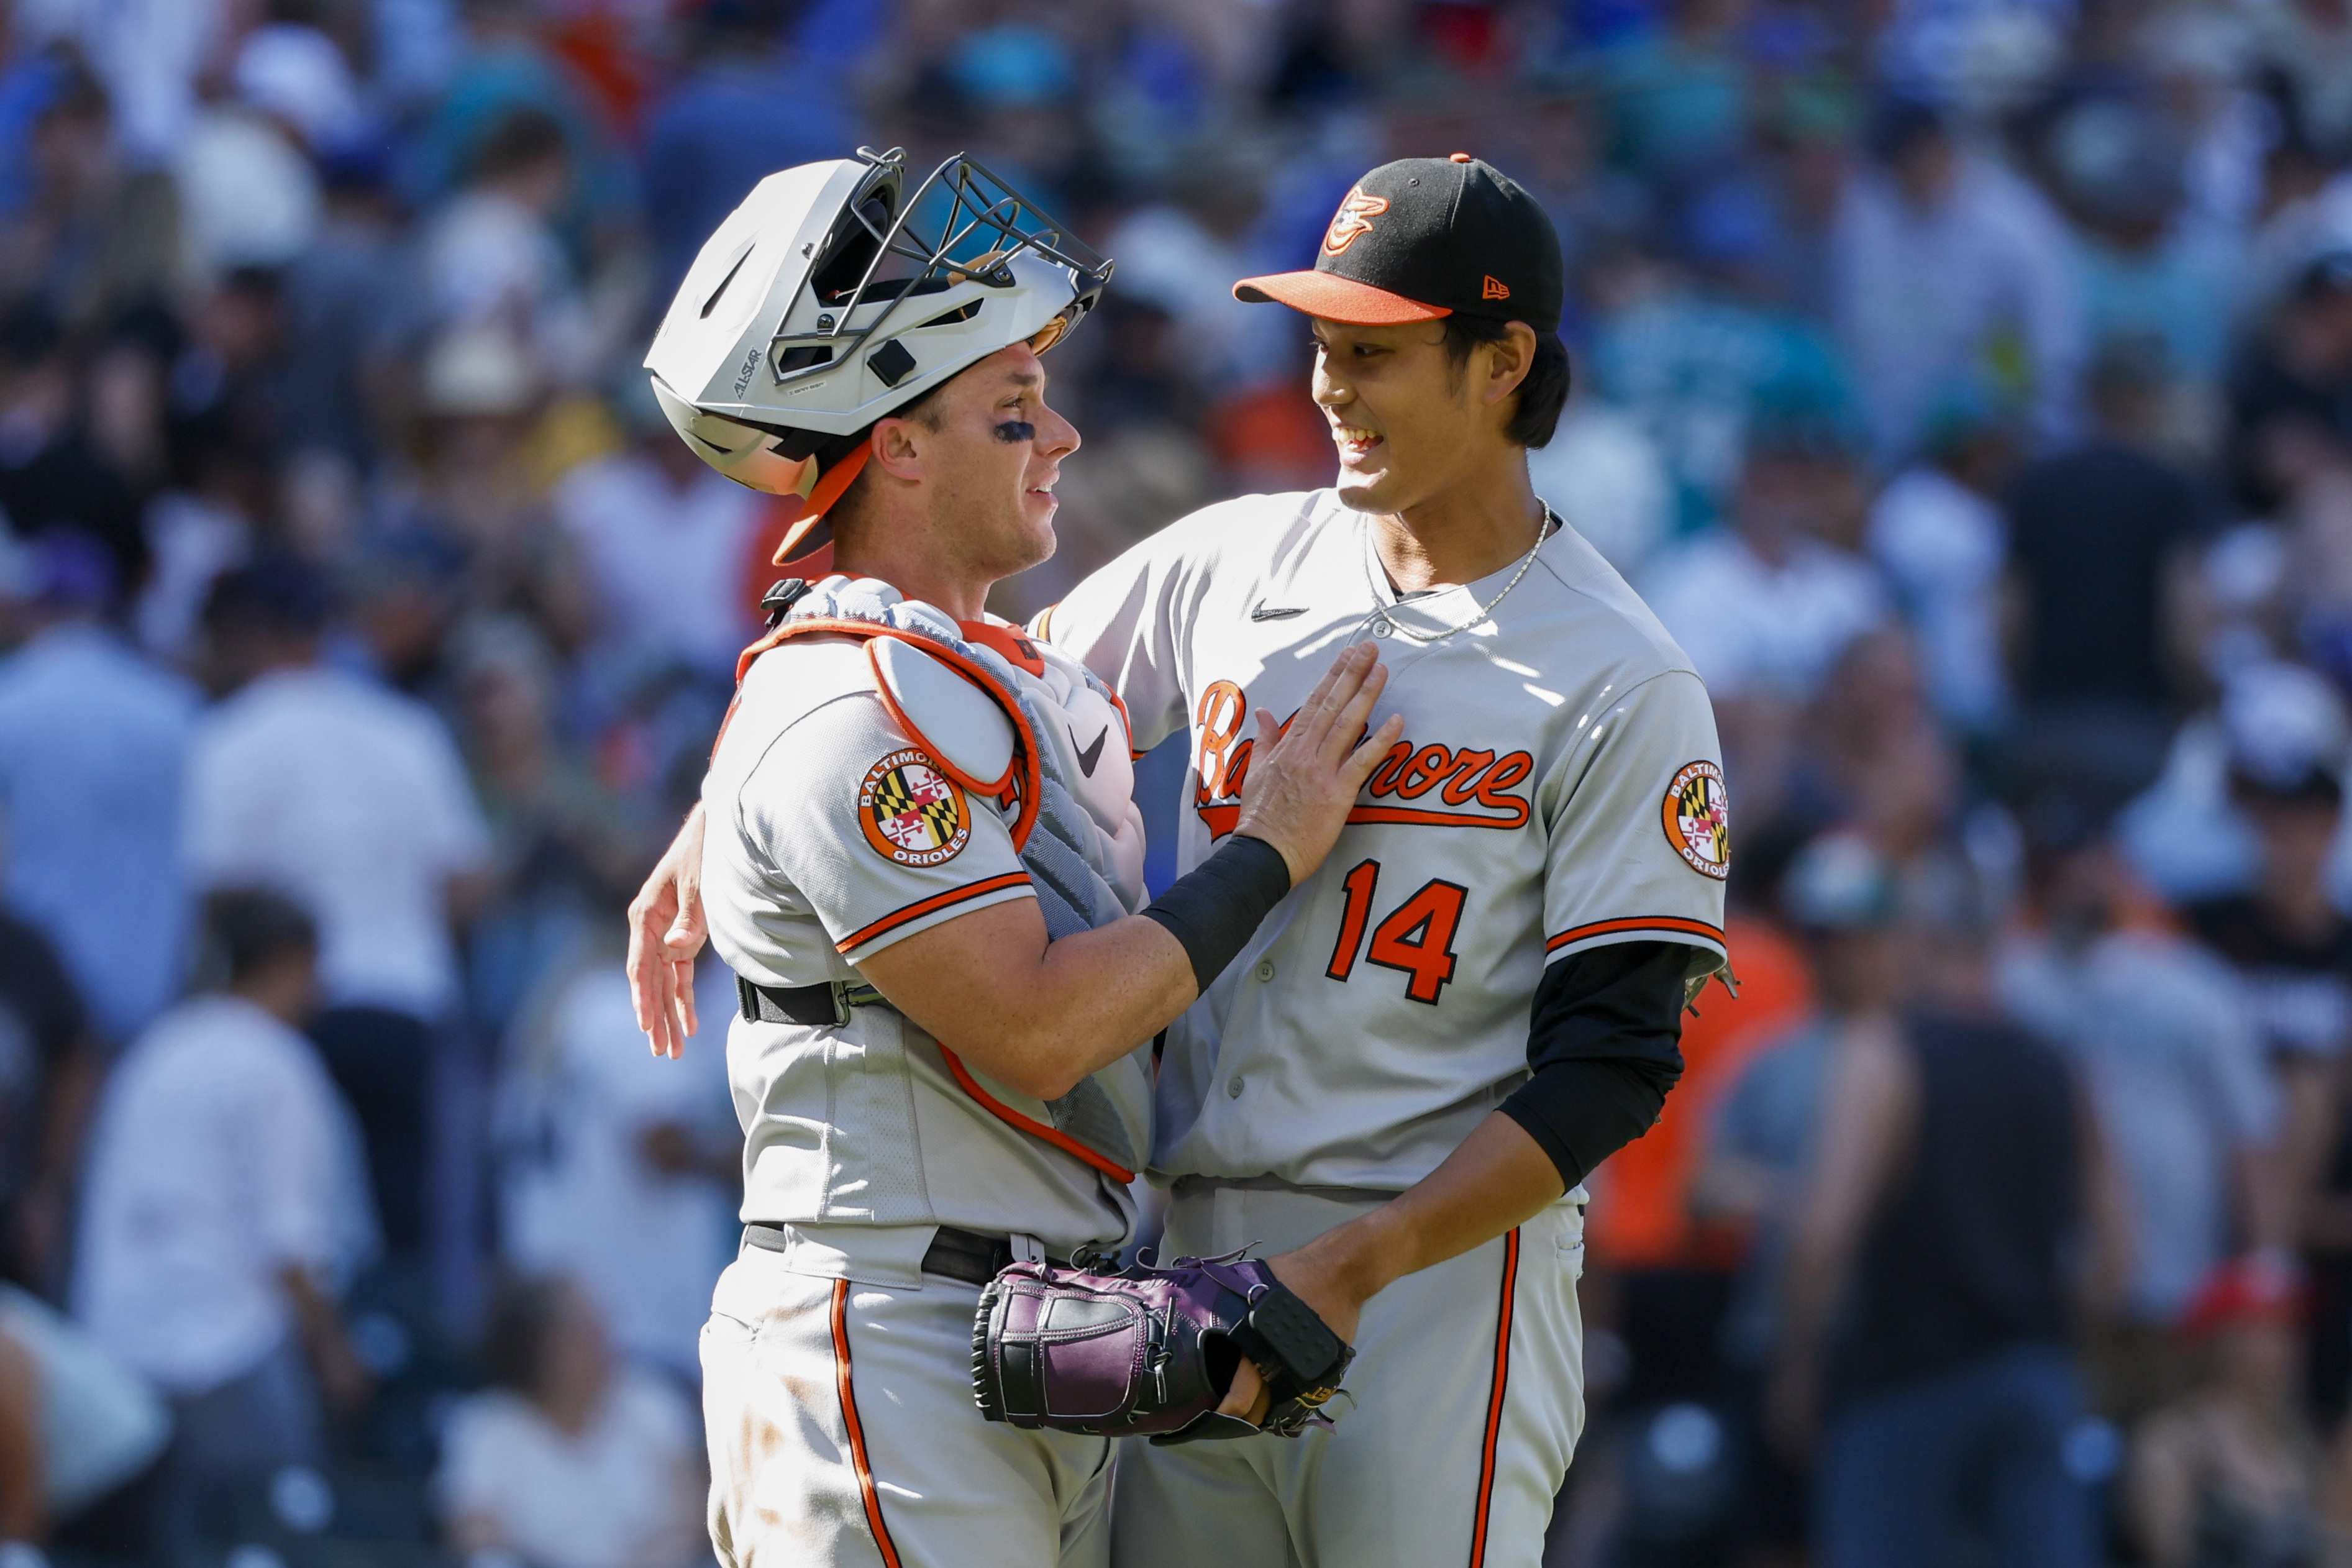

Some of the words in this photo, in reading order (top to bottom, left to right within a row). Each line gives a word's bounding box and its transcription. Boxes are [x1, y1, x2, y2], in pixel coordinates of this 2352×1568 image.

[734, 347, 762, 401] ALL-STAR
[1193, 679, 1534, 809] Baore
[861, 750, 948, 807] BALTIMO
[893, 827, 969, 864] ORIOLES
[1325, 858, 1469, 1006] 14
